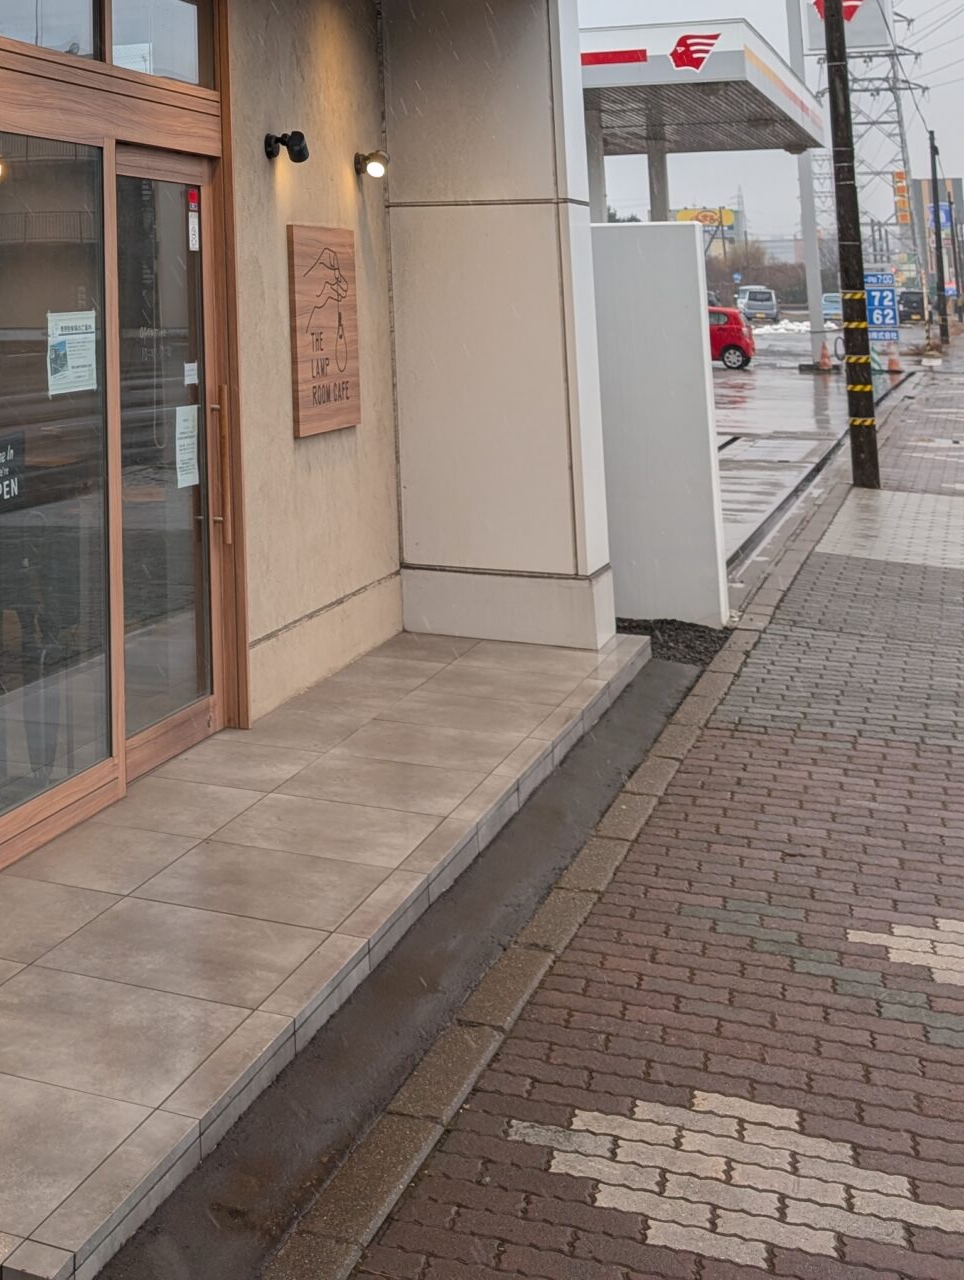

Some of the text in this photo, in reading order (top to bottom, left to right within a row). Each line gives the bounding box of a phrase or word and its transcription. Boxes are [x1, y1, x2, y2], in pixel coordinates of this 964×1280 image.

[311, 331, 324, 352] THE
[311, 357, 330, 379] LAMP
[312, 380, 350, 408] ROOM CAFE
